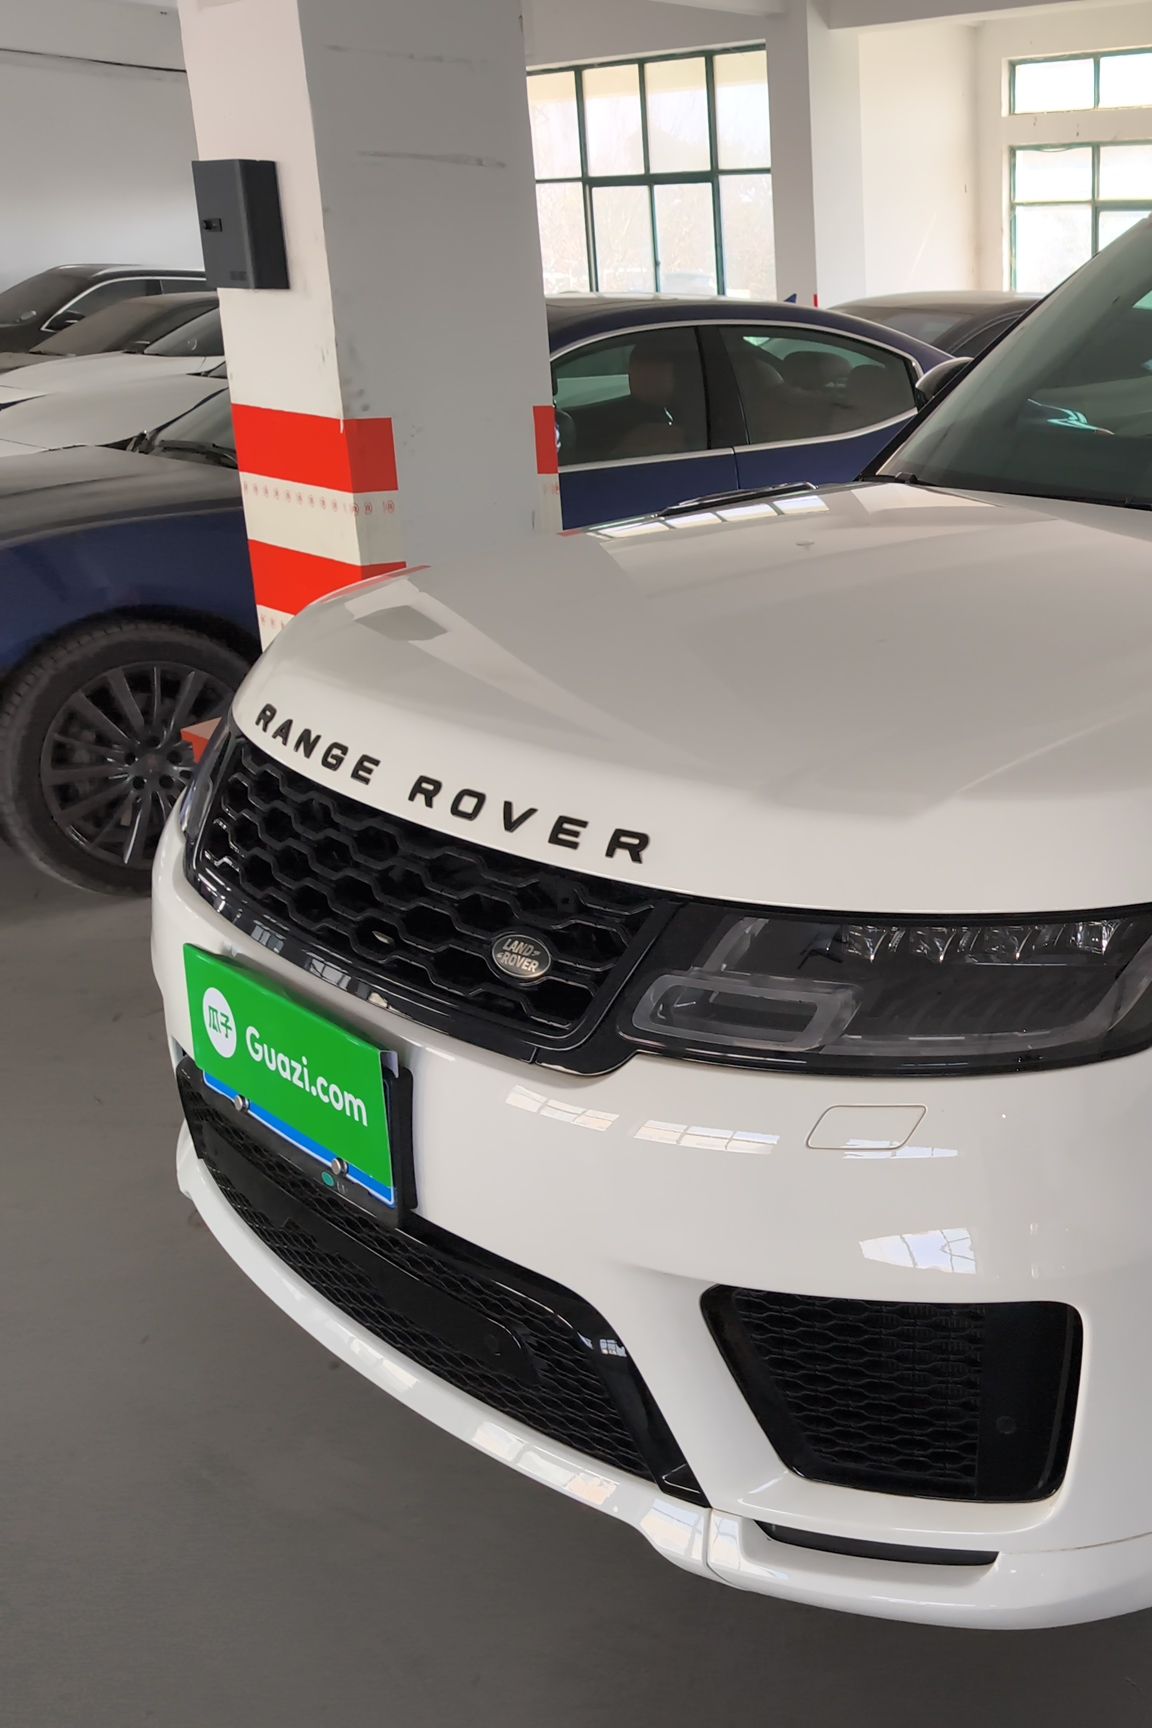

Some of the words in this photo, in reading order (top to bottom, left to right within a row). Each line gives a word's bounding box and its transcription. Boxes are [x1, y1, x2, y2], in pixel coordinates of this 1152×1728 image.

[255, 703, 381, 785] RANGE
[408, 775, 650, 864] ROVER
[502, 951, 539, 972] ROVER
[503, 939, 534, 956] LAND
[208, 1005, 233, 1038] 瓜子
[245, 1025, 368, 1127] Guazi.com
